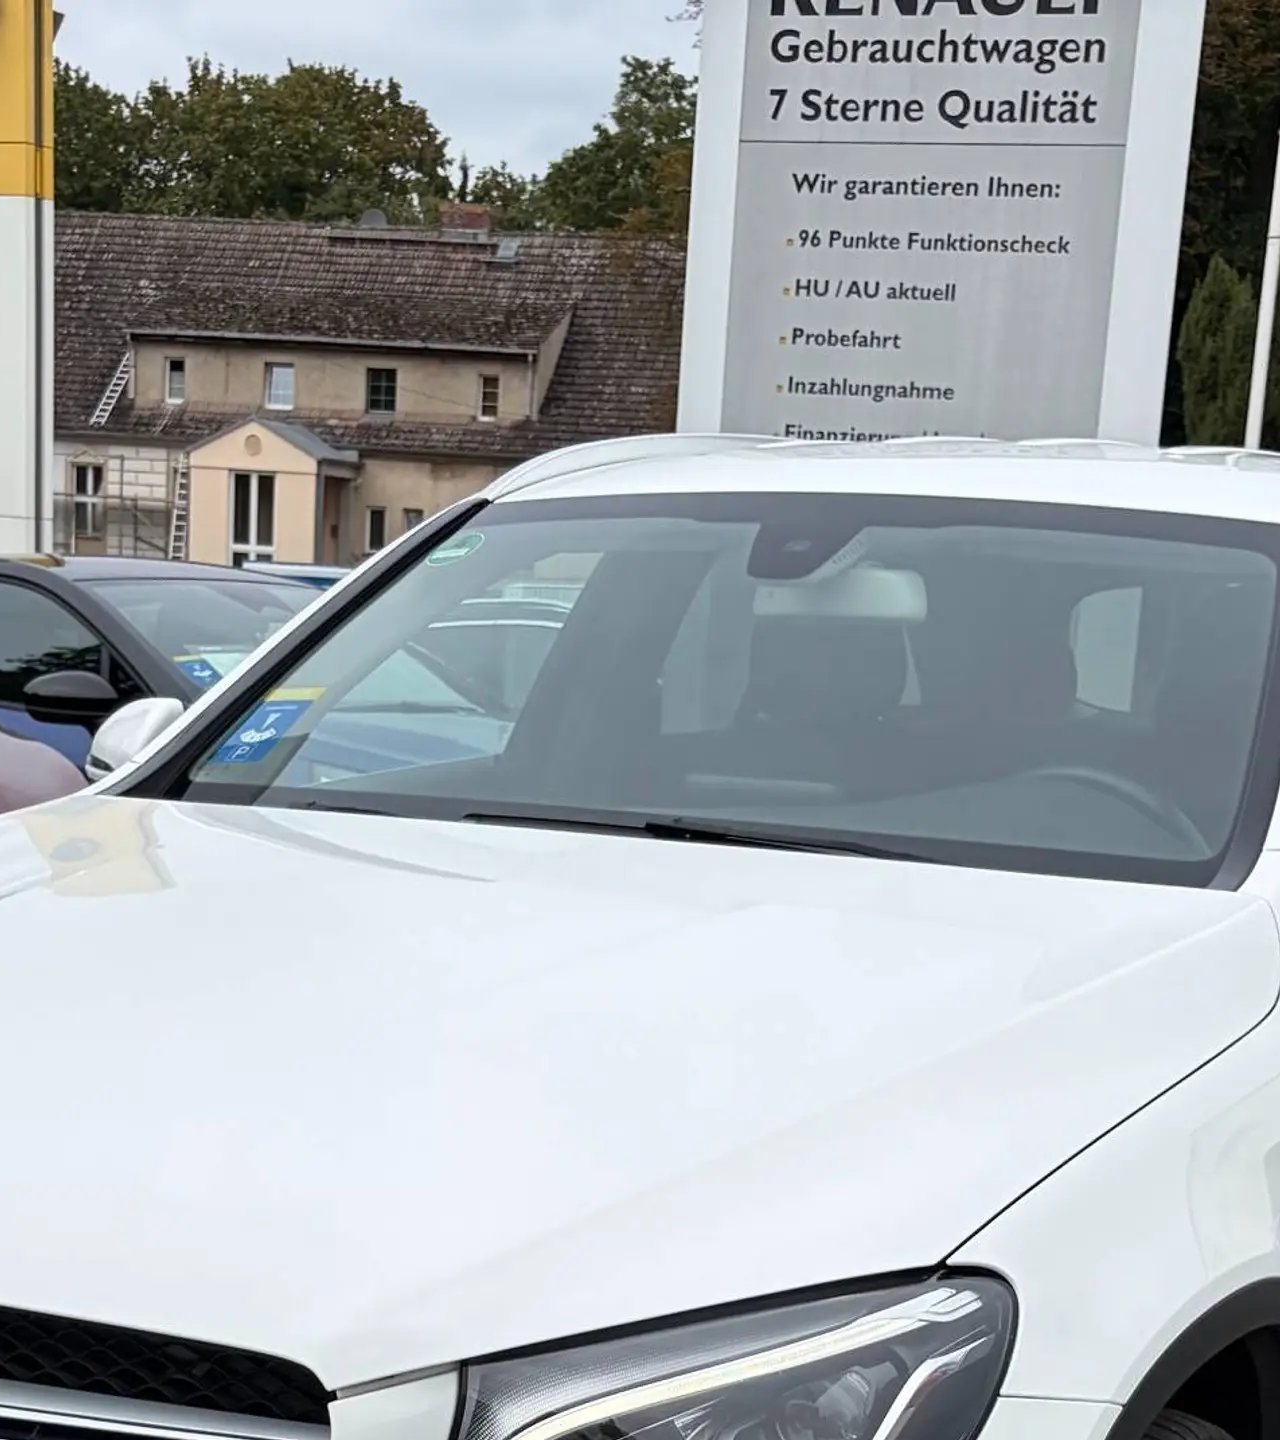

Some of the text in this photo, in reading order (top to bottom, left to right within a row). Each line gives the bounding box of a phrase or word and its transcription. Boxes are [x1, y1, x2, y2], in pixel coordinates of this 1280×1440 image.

[770, 28, 1106, 74] Gebrauchtwagen
[769, 88, 1098, 130] 7 Sterne Qualität
[791, 173, 1061, 201] Wir garantieren Ihnen:
[798, 229, 1070, 254] 96 Punkte Funktionscheck
[794, 278, 956, 302] HU / AU aktuell
[791, 327, 901, 349] Probefahrt
[787, 375, 955, 403] Inzahlungnahme
